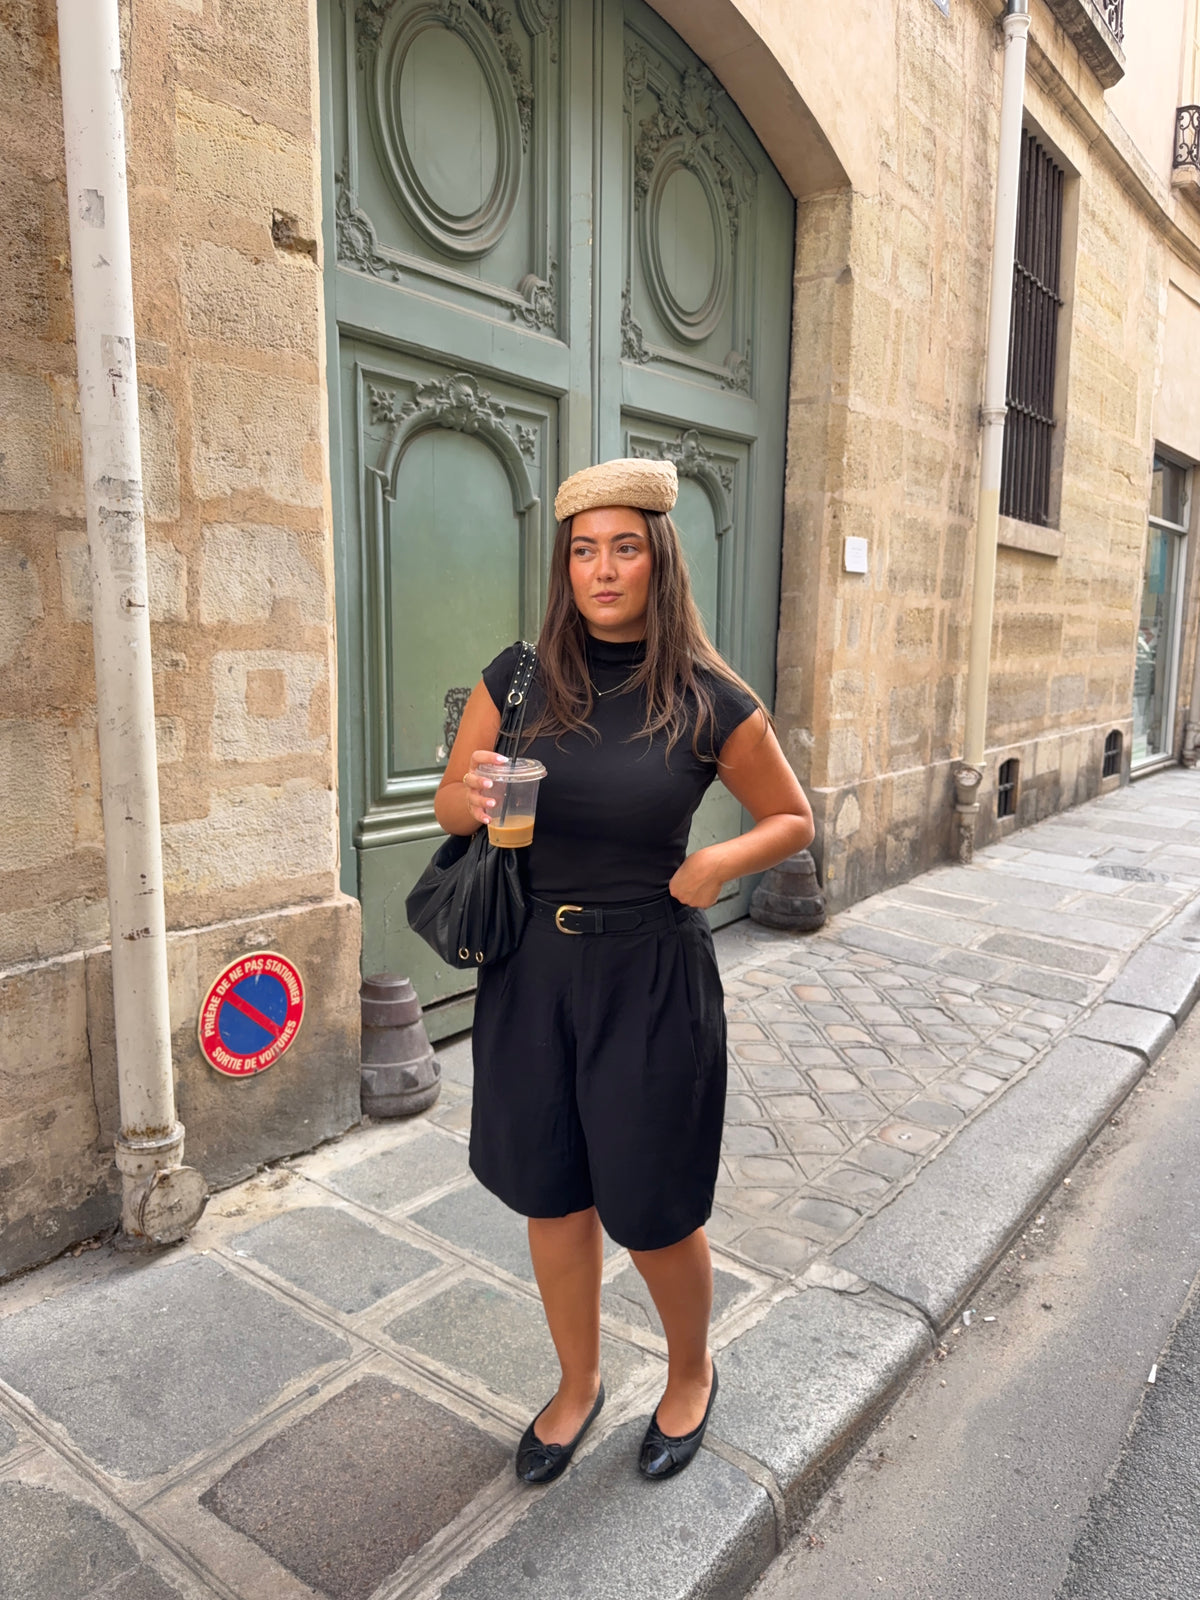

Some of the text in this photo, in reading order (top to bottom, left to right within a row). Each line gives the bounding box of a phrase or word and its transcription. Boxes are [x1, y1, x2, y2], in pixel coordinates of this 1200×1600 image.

[204, 958, 301, 1037] PRIÈRE DE NE PAS STATIONNER
[212, 1020, 296, 1070] SORTIE DE VOITURES
